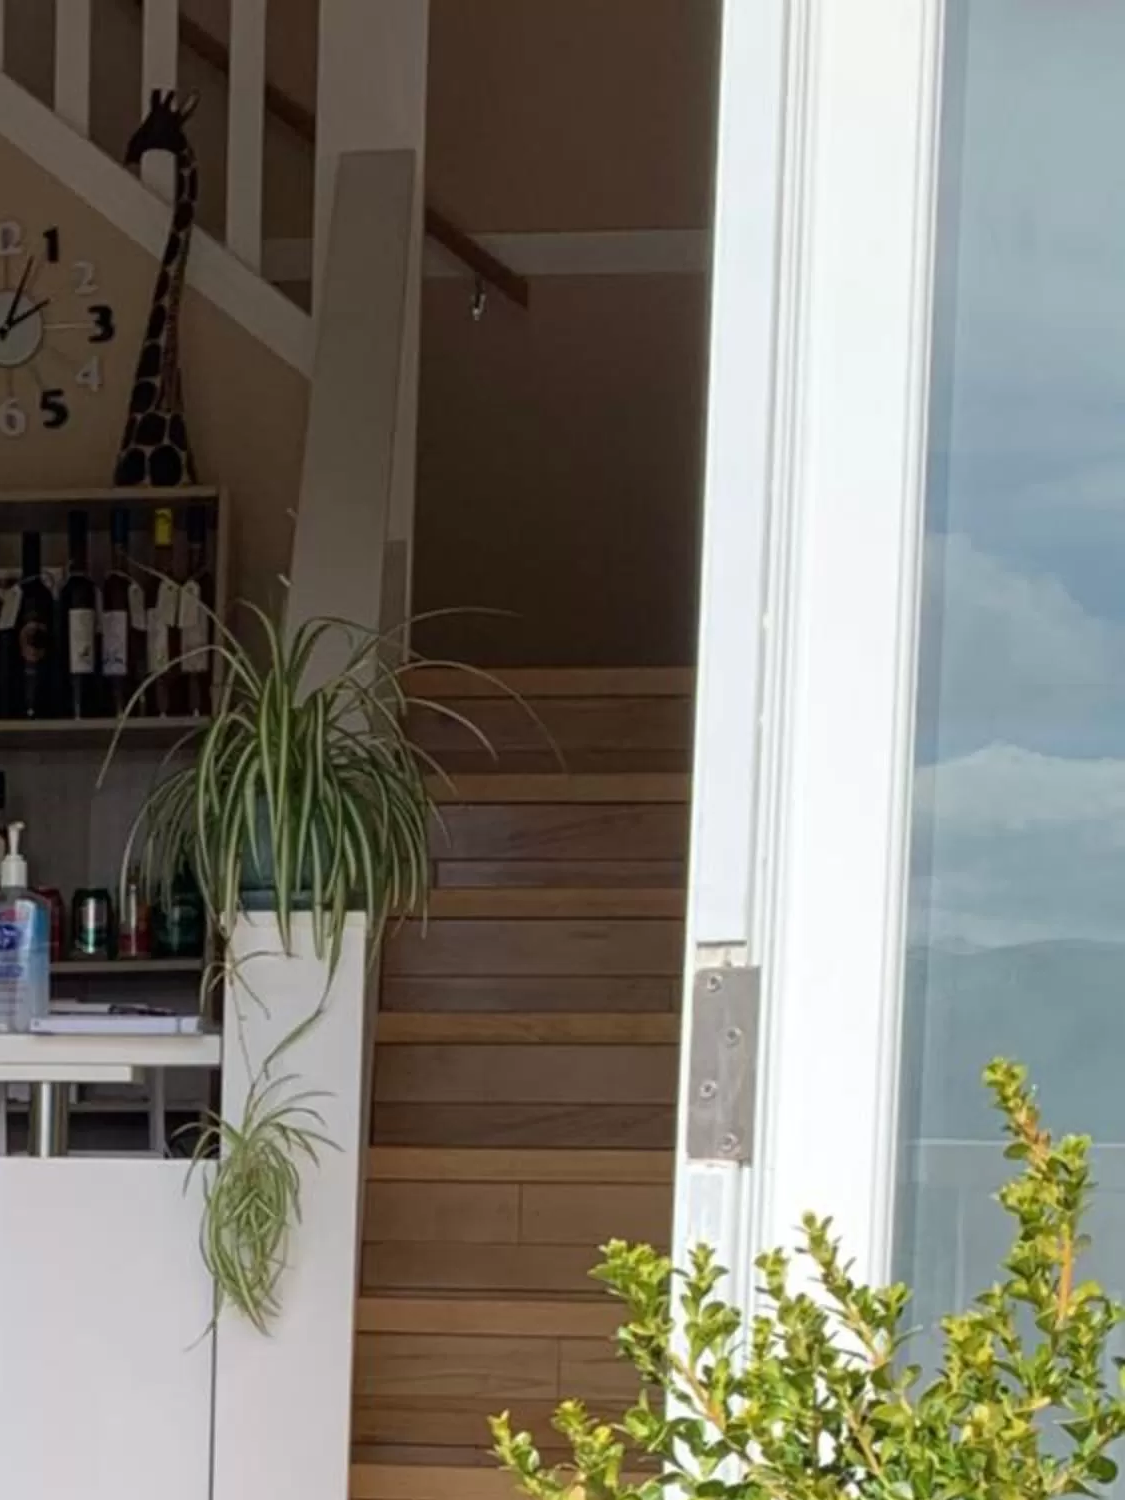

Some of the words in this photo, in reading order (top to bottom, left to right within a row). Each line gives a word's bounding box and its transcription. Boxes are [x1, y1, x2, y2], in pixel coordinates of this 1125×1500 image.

[43, 227, 59, 262] 1
[74, 261, 98, 295] 2
[87, 305, 114, 342] 3
[76, 356, 101, 392] 4
[40, 389, 68, 428] 5
